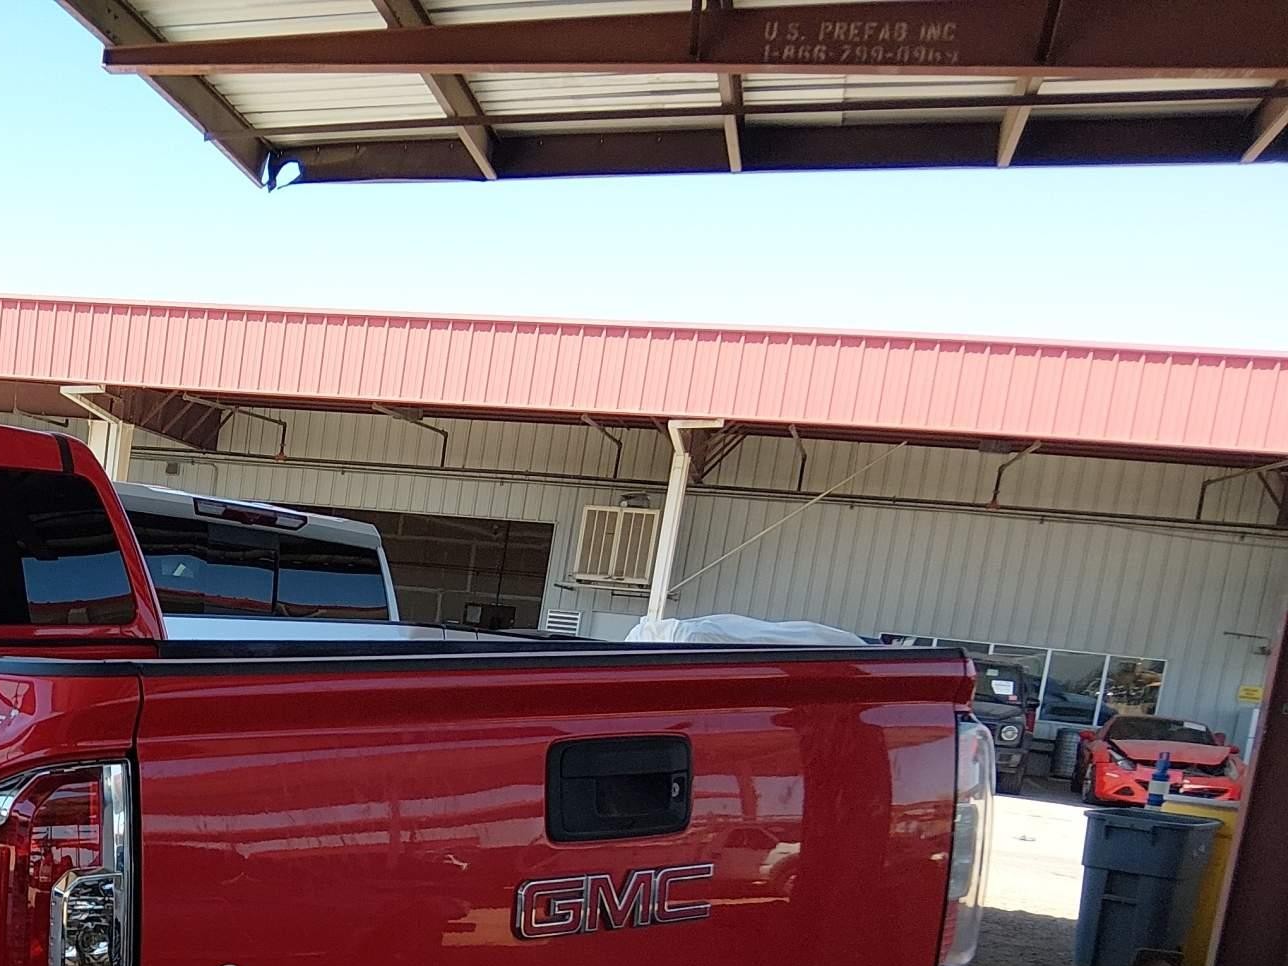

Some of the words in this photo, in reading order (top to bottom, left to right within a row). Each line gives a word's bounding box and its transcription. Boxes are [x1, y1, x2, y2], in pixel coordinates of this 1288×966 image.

[818, 21, 908, 42] PREFAB
[919, 21, 958, 42] INC
[513, 863, 715, 939] GMC
